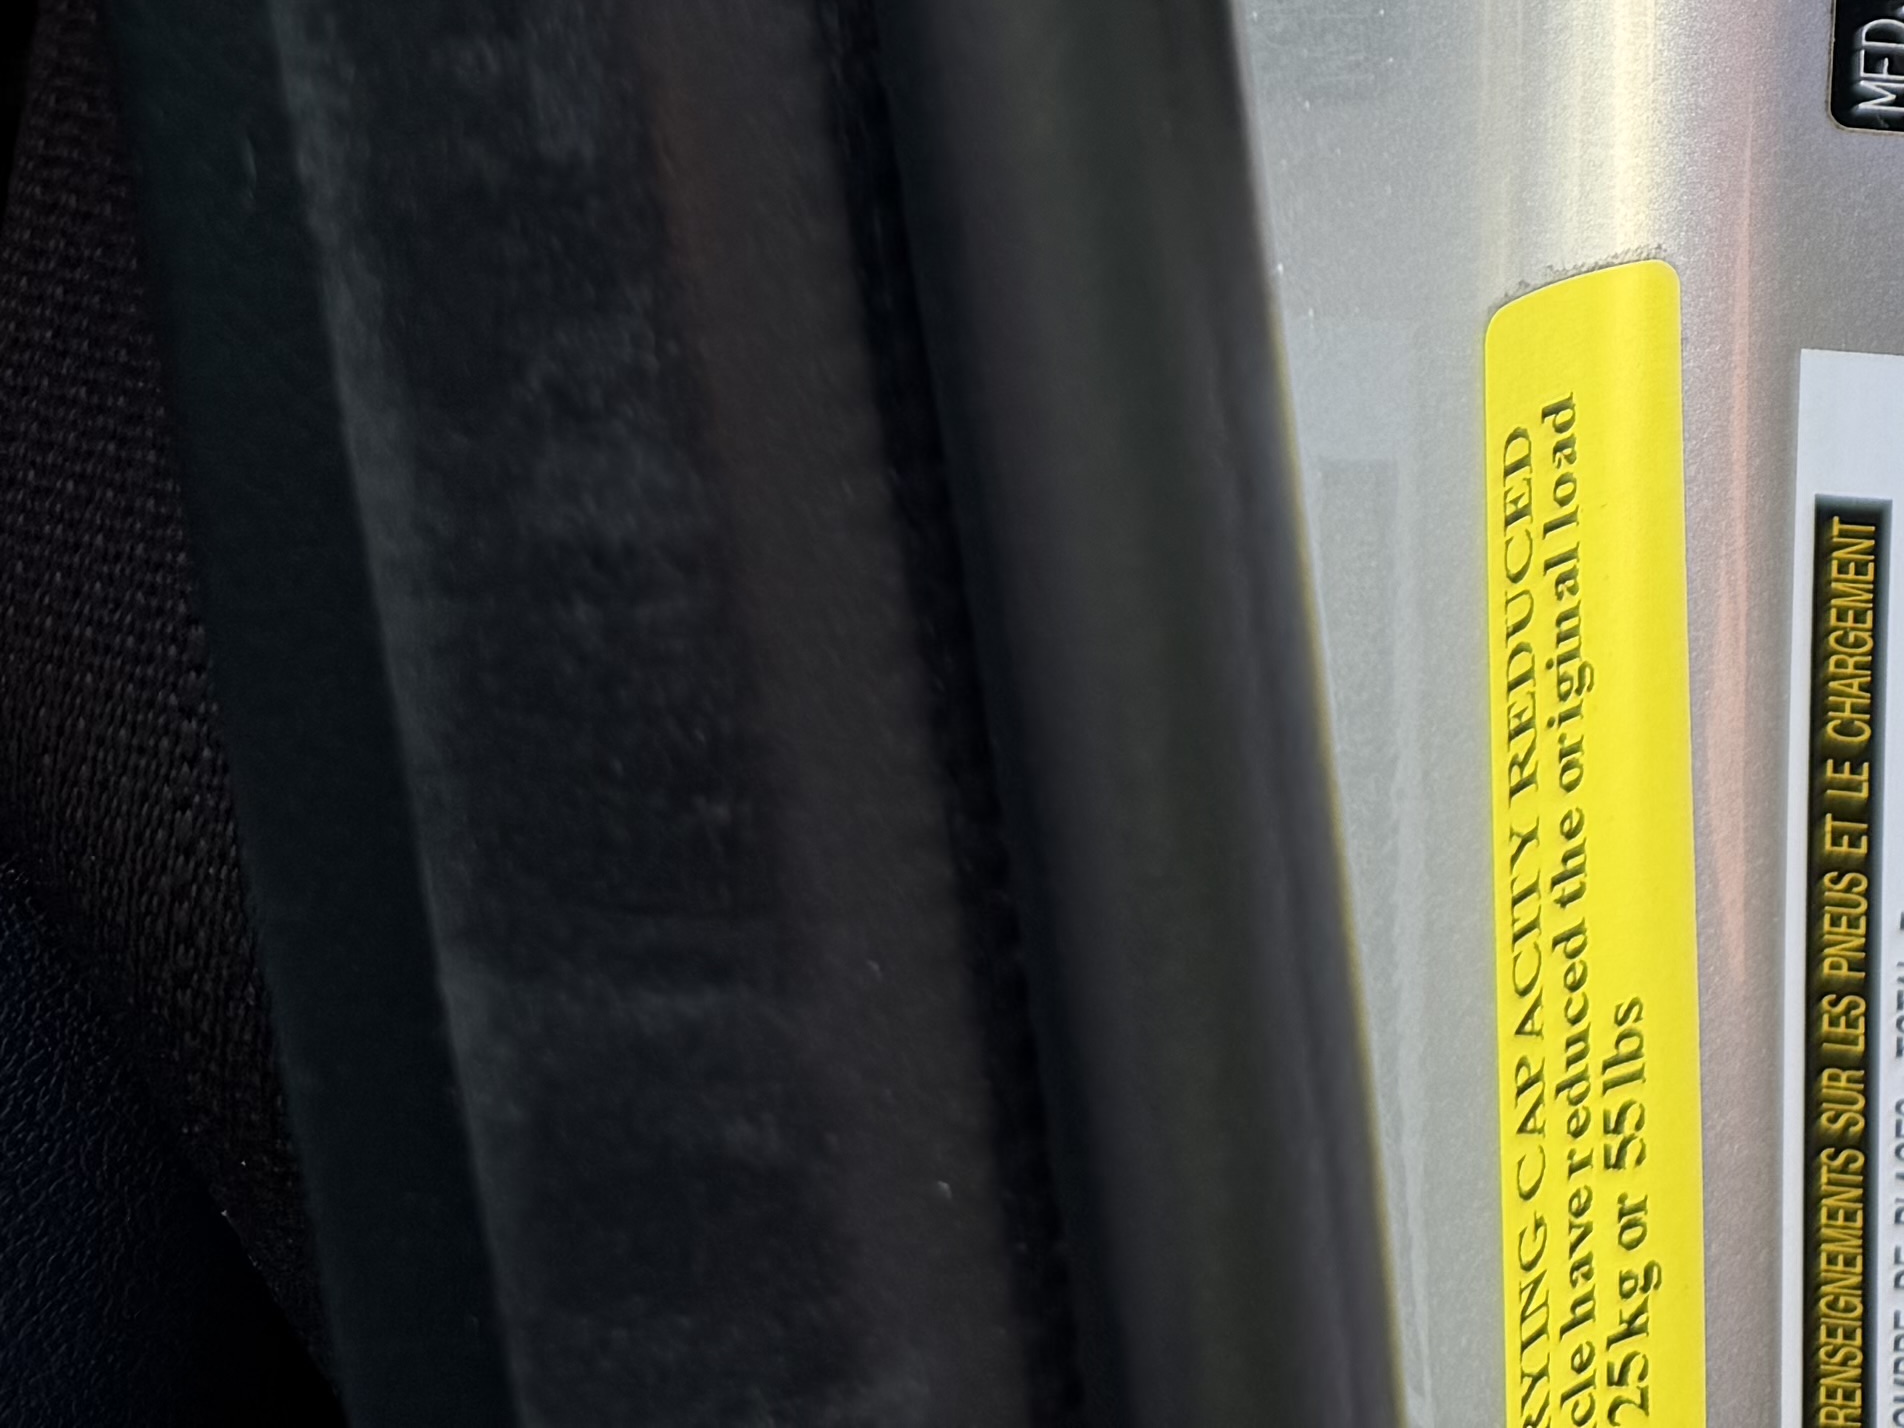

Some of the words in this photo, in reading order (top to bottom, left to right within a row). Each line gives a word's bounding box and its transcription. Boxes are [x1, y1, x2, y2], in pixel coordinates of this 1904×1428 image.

[1540, 391, 1579, 541] load
[1501, 425, 1538, 807] REDUCED
[1542, 542, 1596, 794] original
[1826, 515, 1876, 743] CHARGEMENT
[1824, 813, 1869, 855] ET
[1825, 759, 1871, 801] LE
[1548, 807, 1588, 909] the
[1822, 871, 1870, 979] PNEUS
[1508, 816, 1547, 1202] CAPACITY
[1550, 916, 1594, 1181] reduced
[1821, 994, 1867, 1052] LES
[1820, 1067, 1866, 1129] SUR
[1559, 1184, 1596, 1342] have
[1616, 1191, 1648, 1251] or
[1819, 1146, 1866, 1427] RENSEIGNEMENTS
[1559, 1340, 1597, 1428] cle
